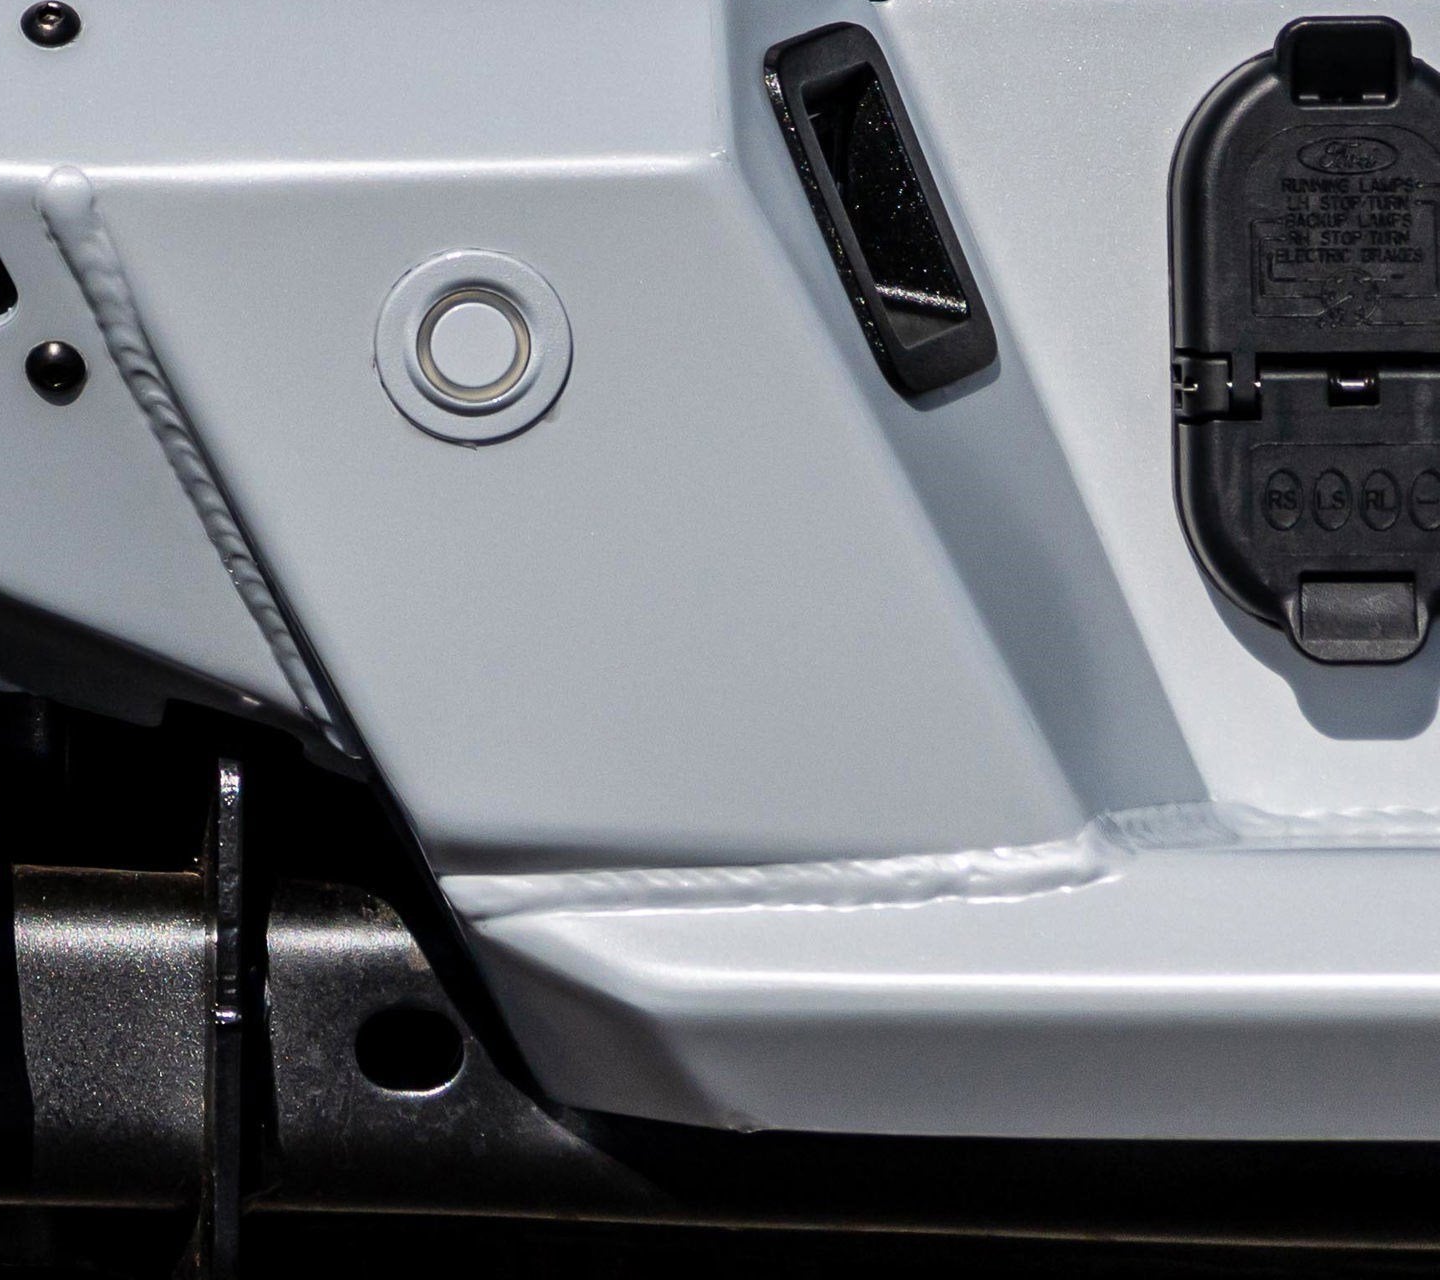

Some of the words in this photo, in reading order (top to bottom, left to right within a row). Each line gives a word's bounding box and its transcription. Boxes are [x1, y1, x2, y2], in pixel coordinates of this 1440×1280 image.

[1281, 178, 1349, 193] RUNNING
[1359, 177, 1415, 193] LAMPS
[1287, 195, 1310, 211] LH
[1285, 213, 1348, 228] BACKUP
[1358, 213, 1413, 228] LAMPS
[1275, 248, 1350, 263] ELECTRIC
[1360, 248, 1424, 263] BRAKES
[1268, 489, 1297, 510] RS
[1316, 489, 1346, 510] LS
[1366, 489, 1397, 511] RL
